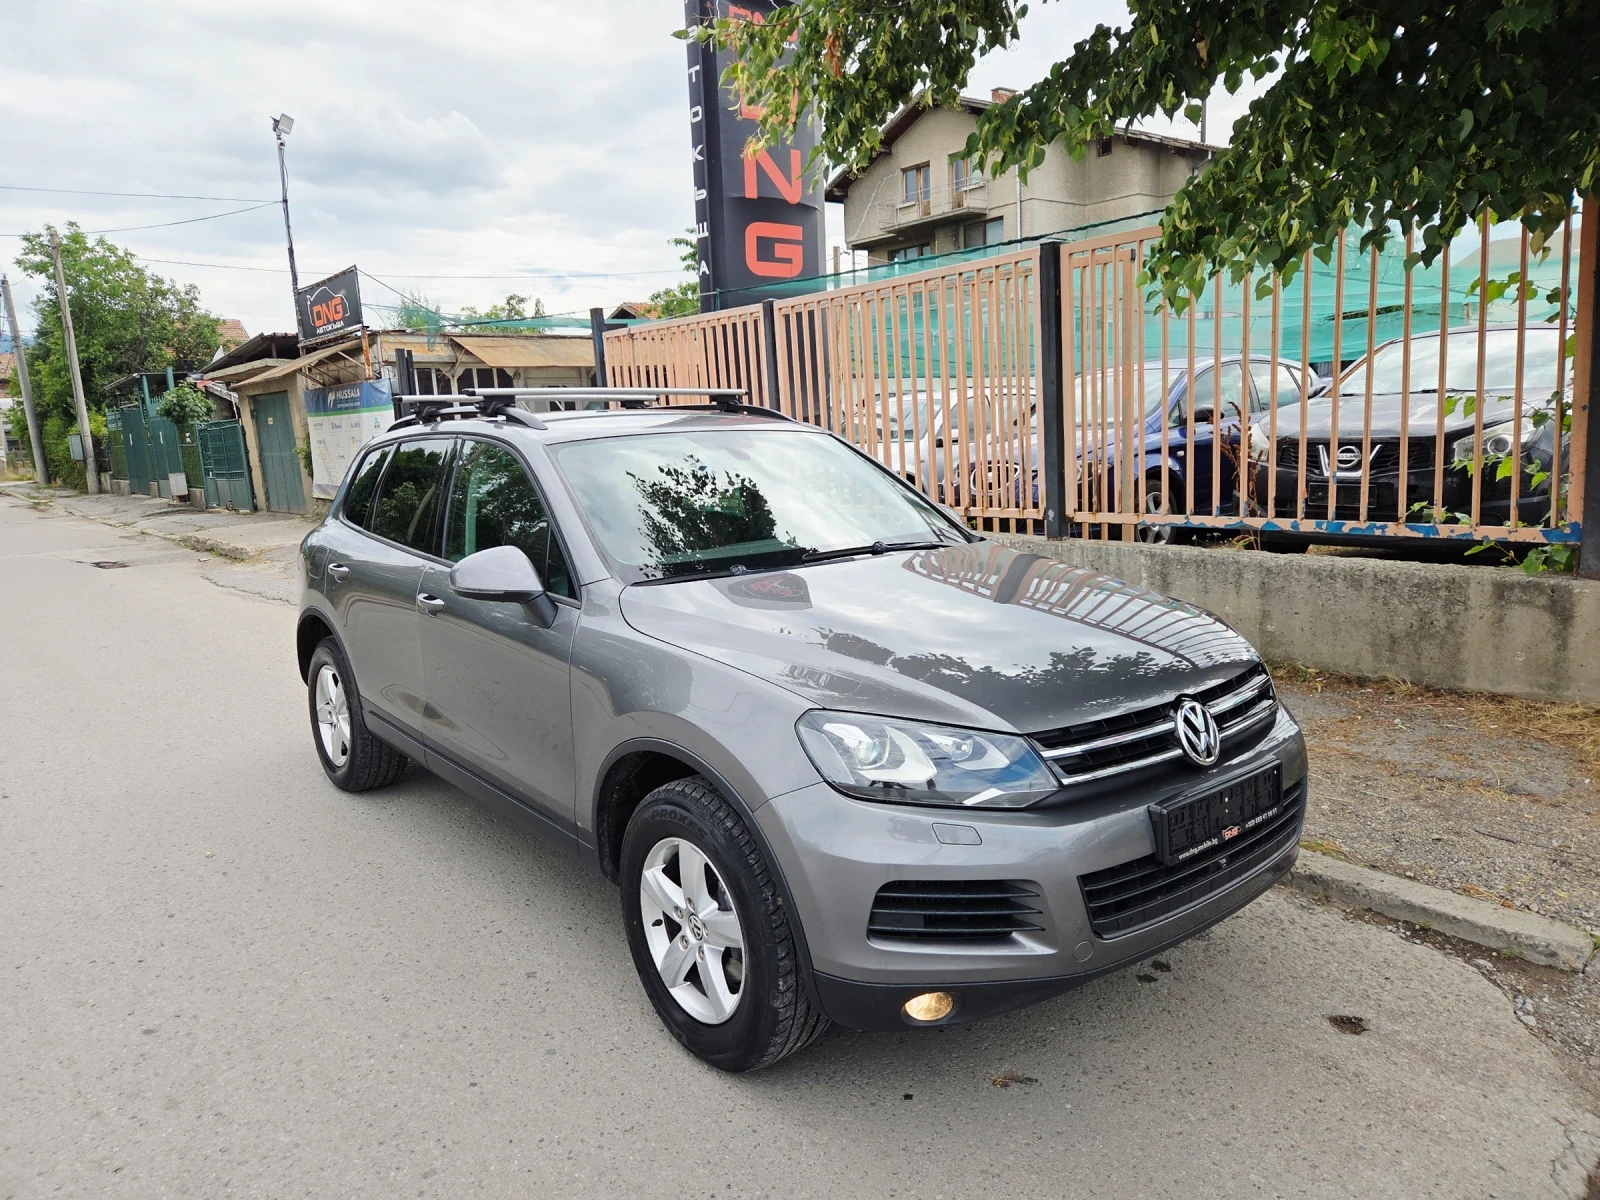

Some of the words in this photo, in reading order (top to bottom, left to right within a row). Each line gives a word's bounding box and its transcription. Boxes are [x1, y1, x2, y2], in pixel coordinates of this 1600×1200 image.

[684, 0, 710, 277] ВТОКЪЩА
[312, 296, 344, 328] DNG
[336, 387, 361, 400] MUSSALA
[650, 808, 709, 839] PROXES
